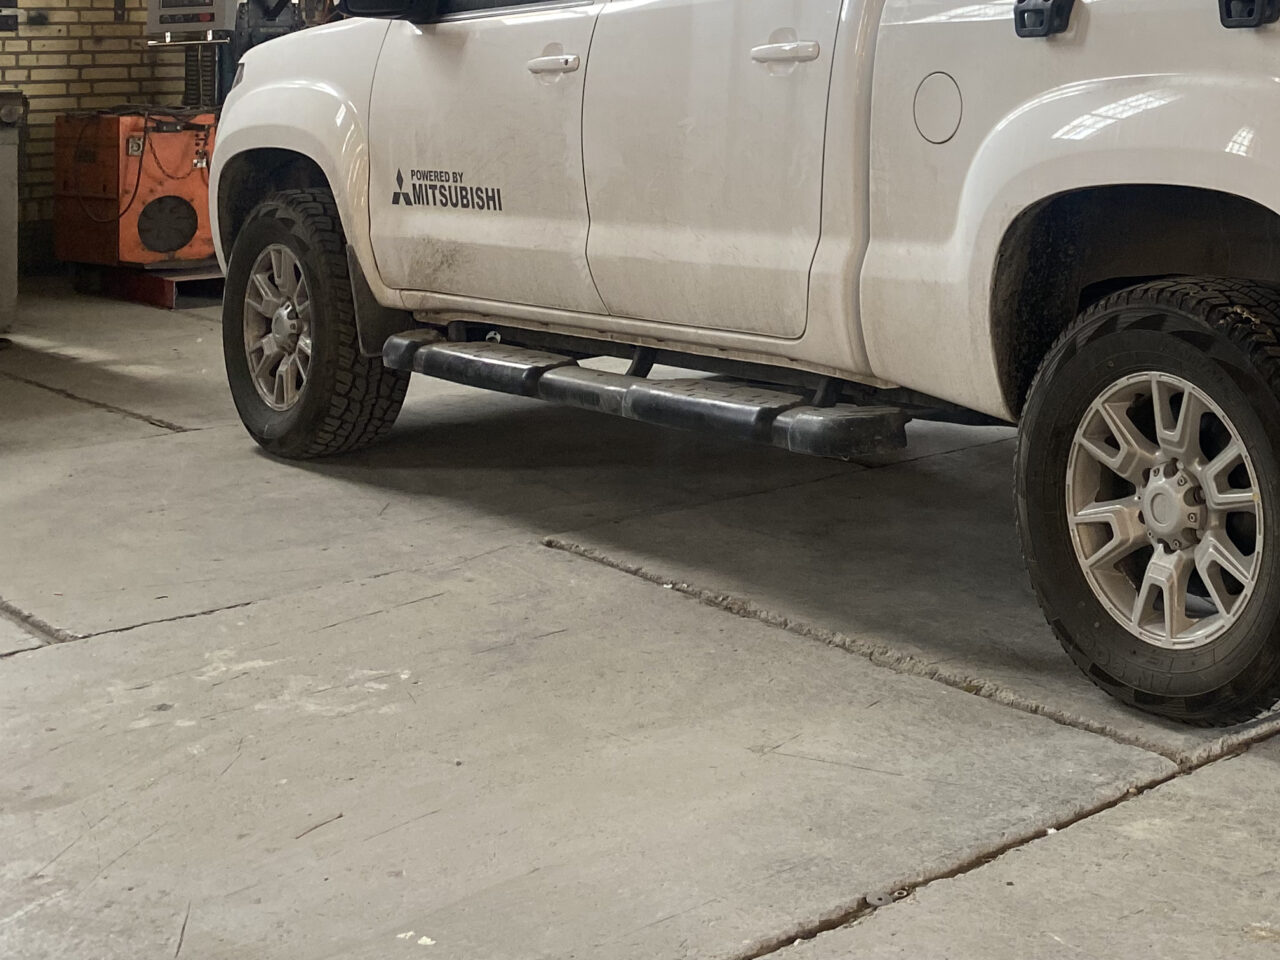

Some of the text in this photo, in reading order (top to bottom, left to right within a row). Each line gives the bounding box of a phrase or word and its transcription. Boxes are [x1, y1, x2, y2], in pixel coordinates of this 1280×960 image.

[411, 169, 464, 184] POWERED BY
[412, 183, 503, 211] MITSUBISHI
